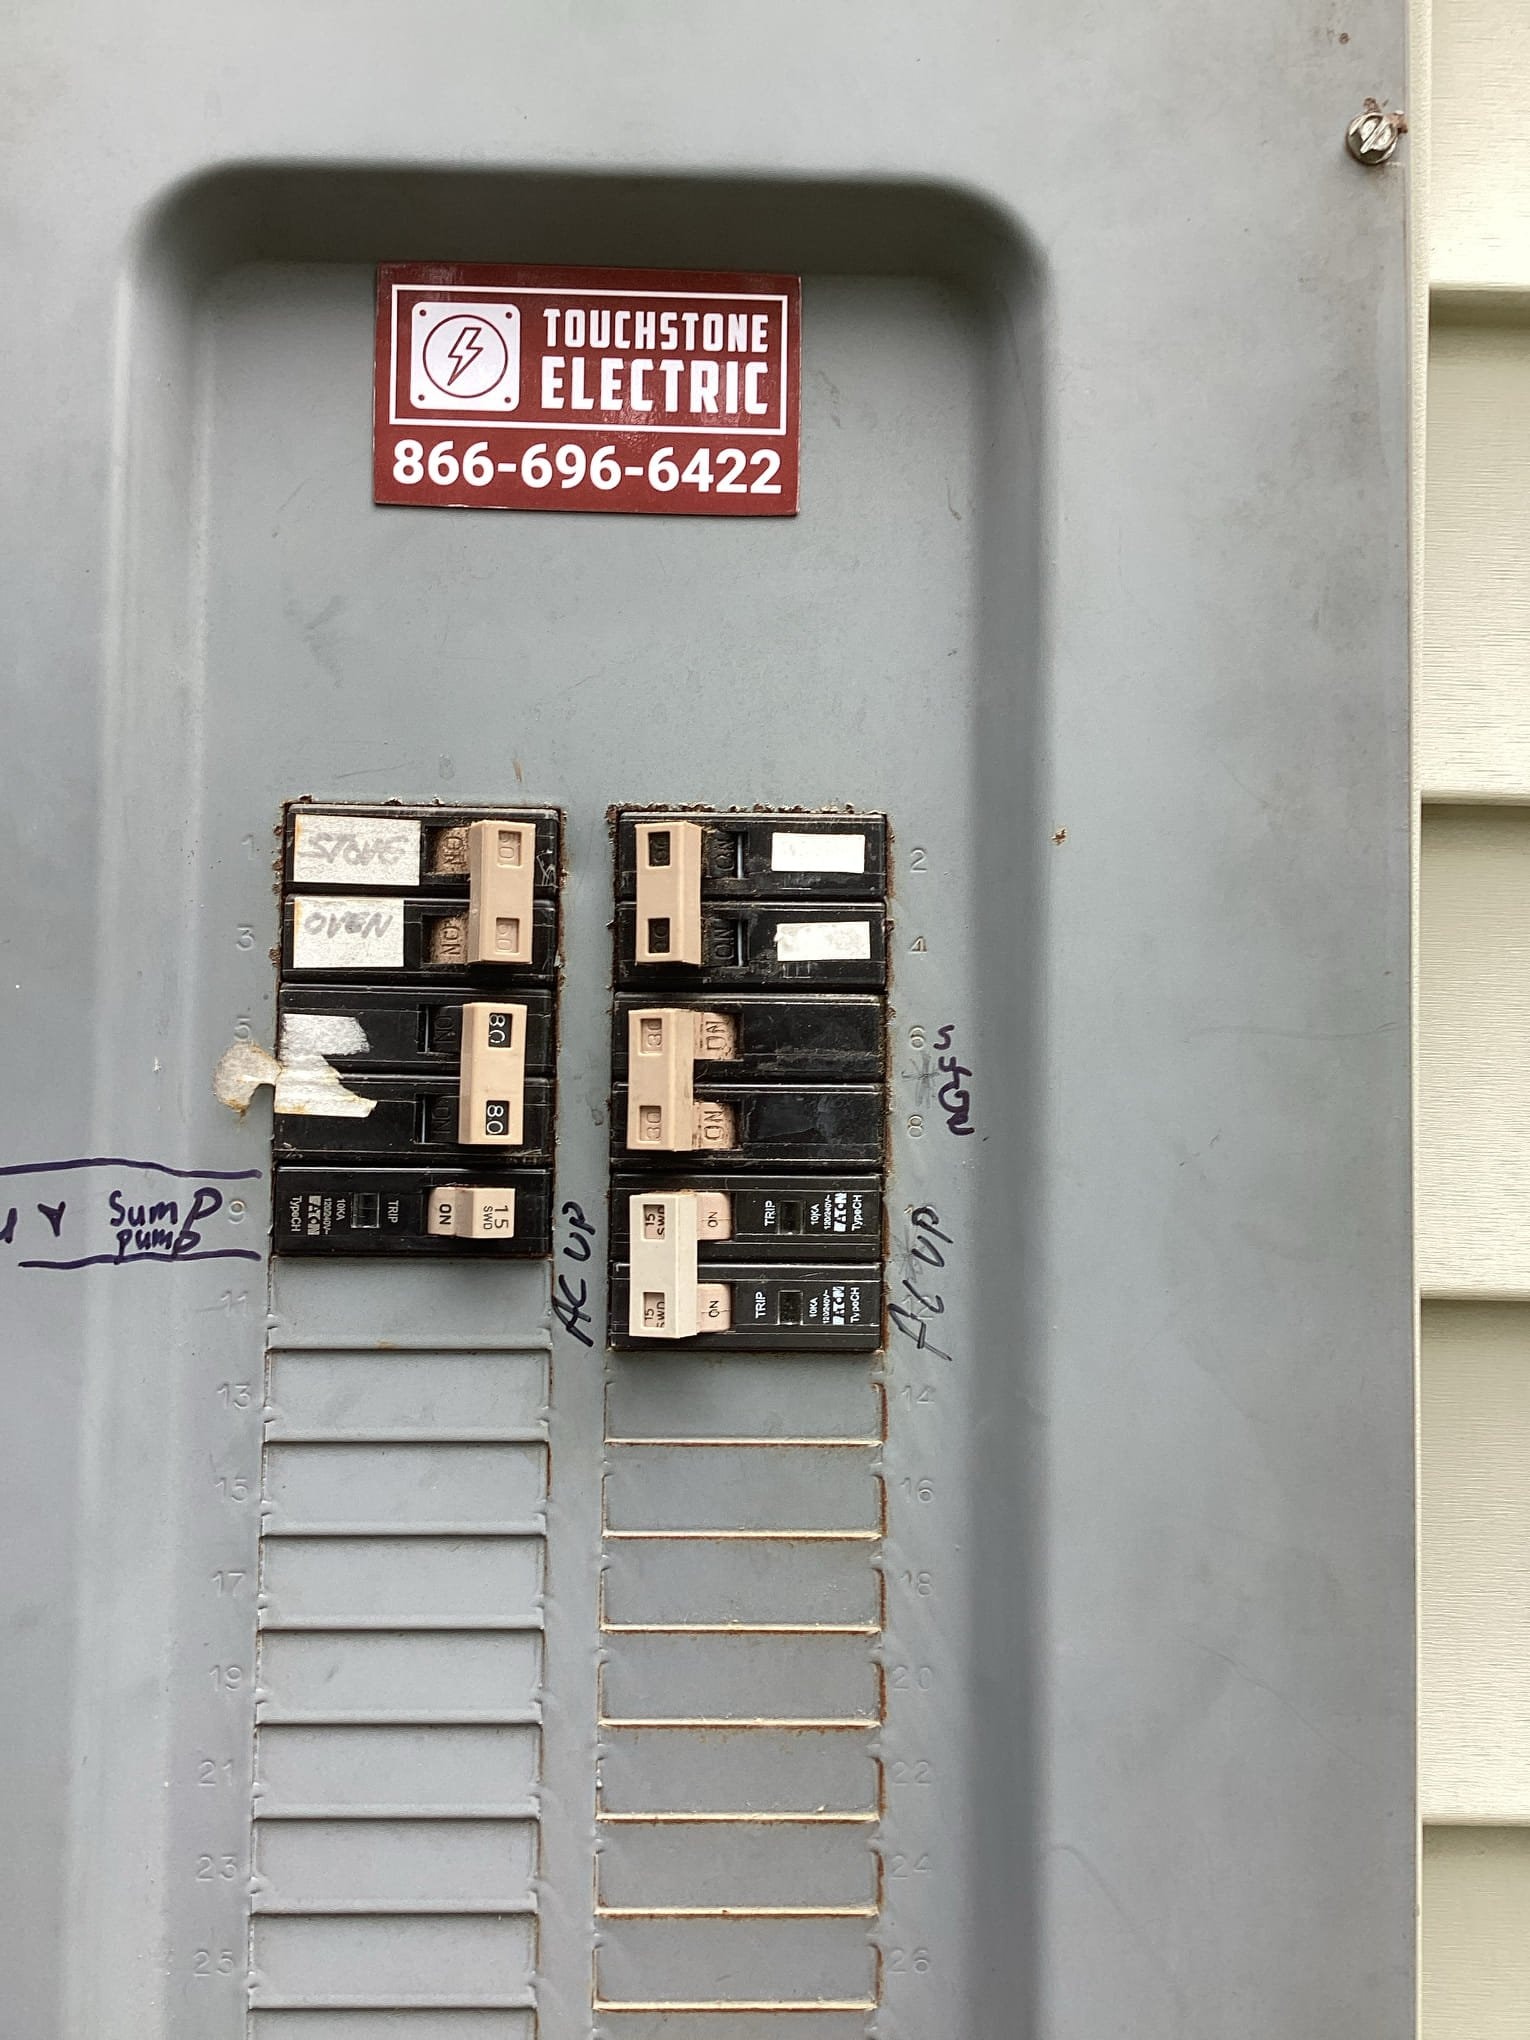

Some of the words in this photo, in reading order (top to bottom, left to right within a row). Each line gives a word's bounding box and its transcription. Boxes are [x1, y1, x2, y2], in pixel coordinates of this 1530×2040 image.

[543, 308, 769, 353] TOUCHSTONE
[541, 356, 769, 414] ELECTRIC
[393, 439, 781, 494] 866-696-6422
[910, 847, 928, 873] 2
[236, 924, 255, 951] 3
[304, 911, 394, 939] OVEN
[440, 925, 461, 955] ON
[908, 935, 928, 961] 4
[705, 1021, 729, 1051] ON
[908, 1025, 926, 1050] 6
[486, 1104, 505, 1135] 80
[646, 1111, 662, 1140] 30
[703, 1110, 724, 1140] ON
[908, 1114, 924, 1138] 8
[228, 1199, 246, 1224] 9
[307, 1195, 321, 1236] EATON
[387, 1200, 399, 1224] TRIP
[439, 1203, 452, 1225] ON
[483, 1205, 493, 1230] SWD
[495, 1205, 509, 1229] 15
[644, 1213, 656, 1227] 15
[708, 1211, 718, 1228] ON
[764, 1200, 775, 1227] TRIP
[834, 1192, 847, 1232] EATON
[562, 1201, 596, 1261] UP
[911, 1206, 954, 1267] UP
[220, 1289, 248, 1317] 11
[552, 1274, 594, 1347] AC
[644, 1308, 655, 1321] 15
[709, 1300, 720, 1318] ON
[755, 1291, 766, 1319] TRIP
[833, 1286, 845, 1325] EATON
[216, 1383, 251, 1409] 13
[900, 1384, 936, 1411] 14
[214, 1477, 249, 1502] 15
[900, 1477, 935, 1503] 16
[211, 1570, 247, 1598] 17
[900, 1570, 934, 1597] 18
[208, 1664, 244, 1692] 19
[892, 1665, 933, 1692] 20
[198, 1759, 235, 1788] 21
[891, 1759, 933, 1787] 22
[196, 1855, 238, 1883] 23
[890, 1854, 932, 1880] 24
[192, 1950, 236, 1978] 25
[888, 1948, 931, 1976] 26
